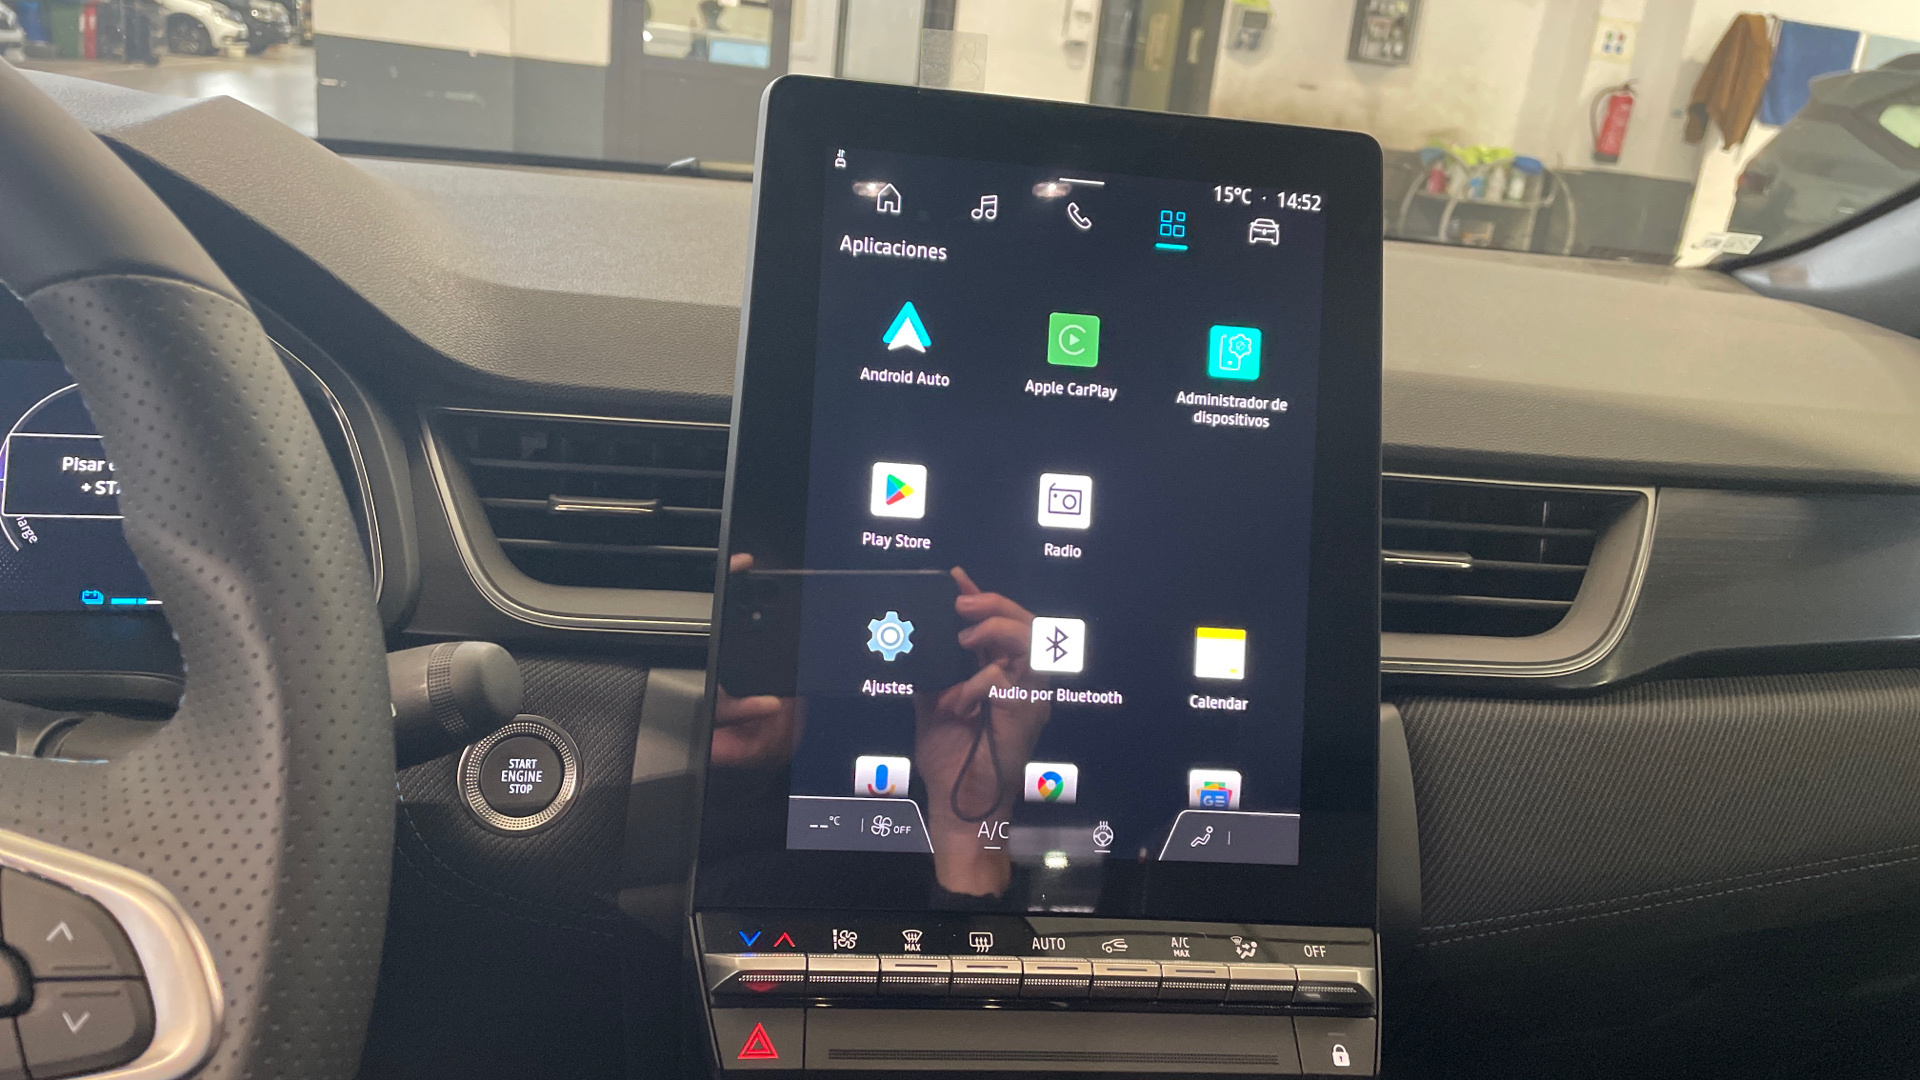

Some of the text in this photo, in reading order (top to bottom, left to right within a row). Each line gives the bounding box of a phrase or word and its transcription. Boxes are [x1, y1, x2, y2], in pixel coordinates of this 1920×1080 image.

[1277, 191, 1322, 212] 14:52
[839, 234, 948, 262] Aplicaciones
[860, 366, 950, 387] Android Auto
[1024, 378, 1118, 402] Apple CarPlay
[1176, 390, 1289, 411] Administrador de
[1192, 409, 1271, 428] dispositivos
[62, 456, 106, 471] Pisar
[94, 480, 122, 495] ST
[862, 531, 932, 551] Play Store
[1043, 542, 1083, 559] Radio
[861, 679, 914, 697] Ajustes
[988, 685, 1124, 706] Audio por Bluetooth
[1188, 694, 1250, 711] Calendar
[508, 758, 538, 769] START
[500, 770, 543, 783] ENGINE
[508, 784, 534, 795] STOP
[892, 825, 913, 835] OFF
[976, 820, 1011, 842] A/C
[904, 943, 922, 952] MAX
[1031, 937, 1067, 951] AUTO
[1170, 936, 1190, 950] A/C
[1173, 949, 1191, 958] MAX
[1303, 945, 1327, 959] OFF
